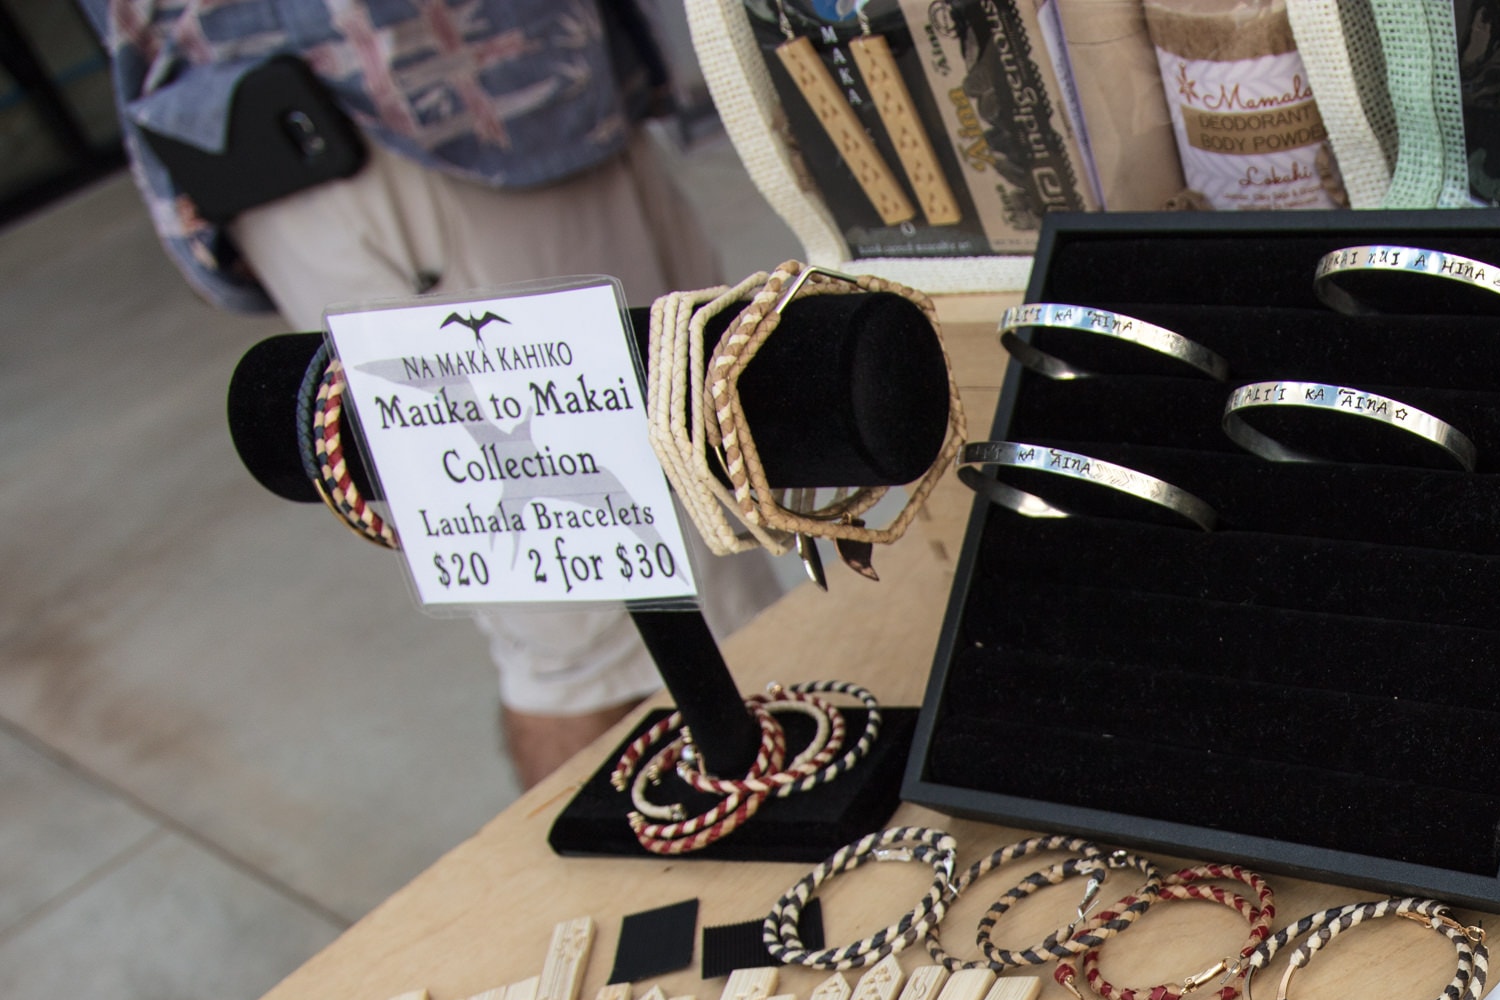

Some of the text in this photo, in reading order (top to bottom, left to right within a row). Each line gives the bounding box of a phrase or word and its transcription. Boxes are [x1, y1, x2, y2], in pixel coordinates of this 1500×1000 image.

[1199, 105, 1312, 131] DEODORANT
[1253, 124, 1328, 149] POWDE
[402, 341, 574, 381] NA MAKA KAHIKO
[375, 374, 634, 431] Mauka to Makai
[1305, 387, 1325, 401] KA
[441, 444, 601, 485] Collection
[1017, 447, 1035, 461] KA
[418, 494, 656, 539] Lauhala Bracelets
[432, 535, 677, 594] $20 2 for $30
